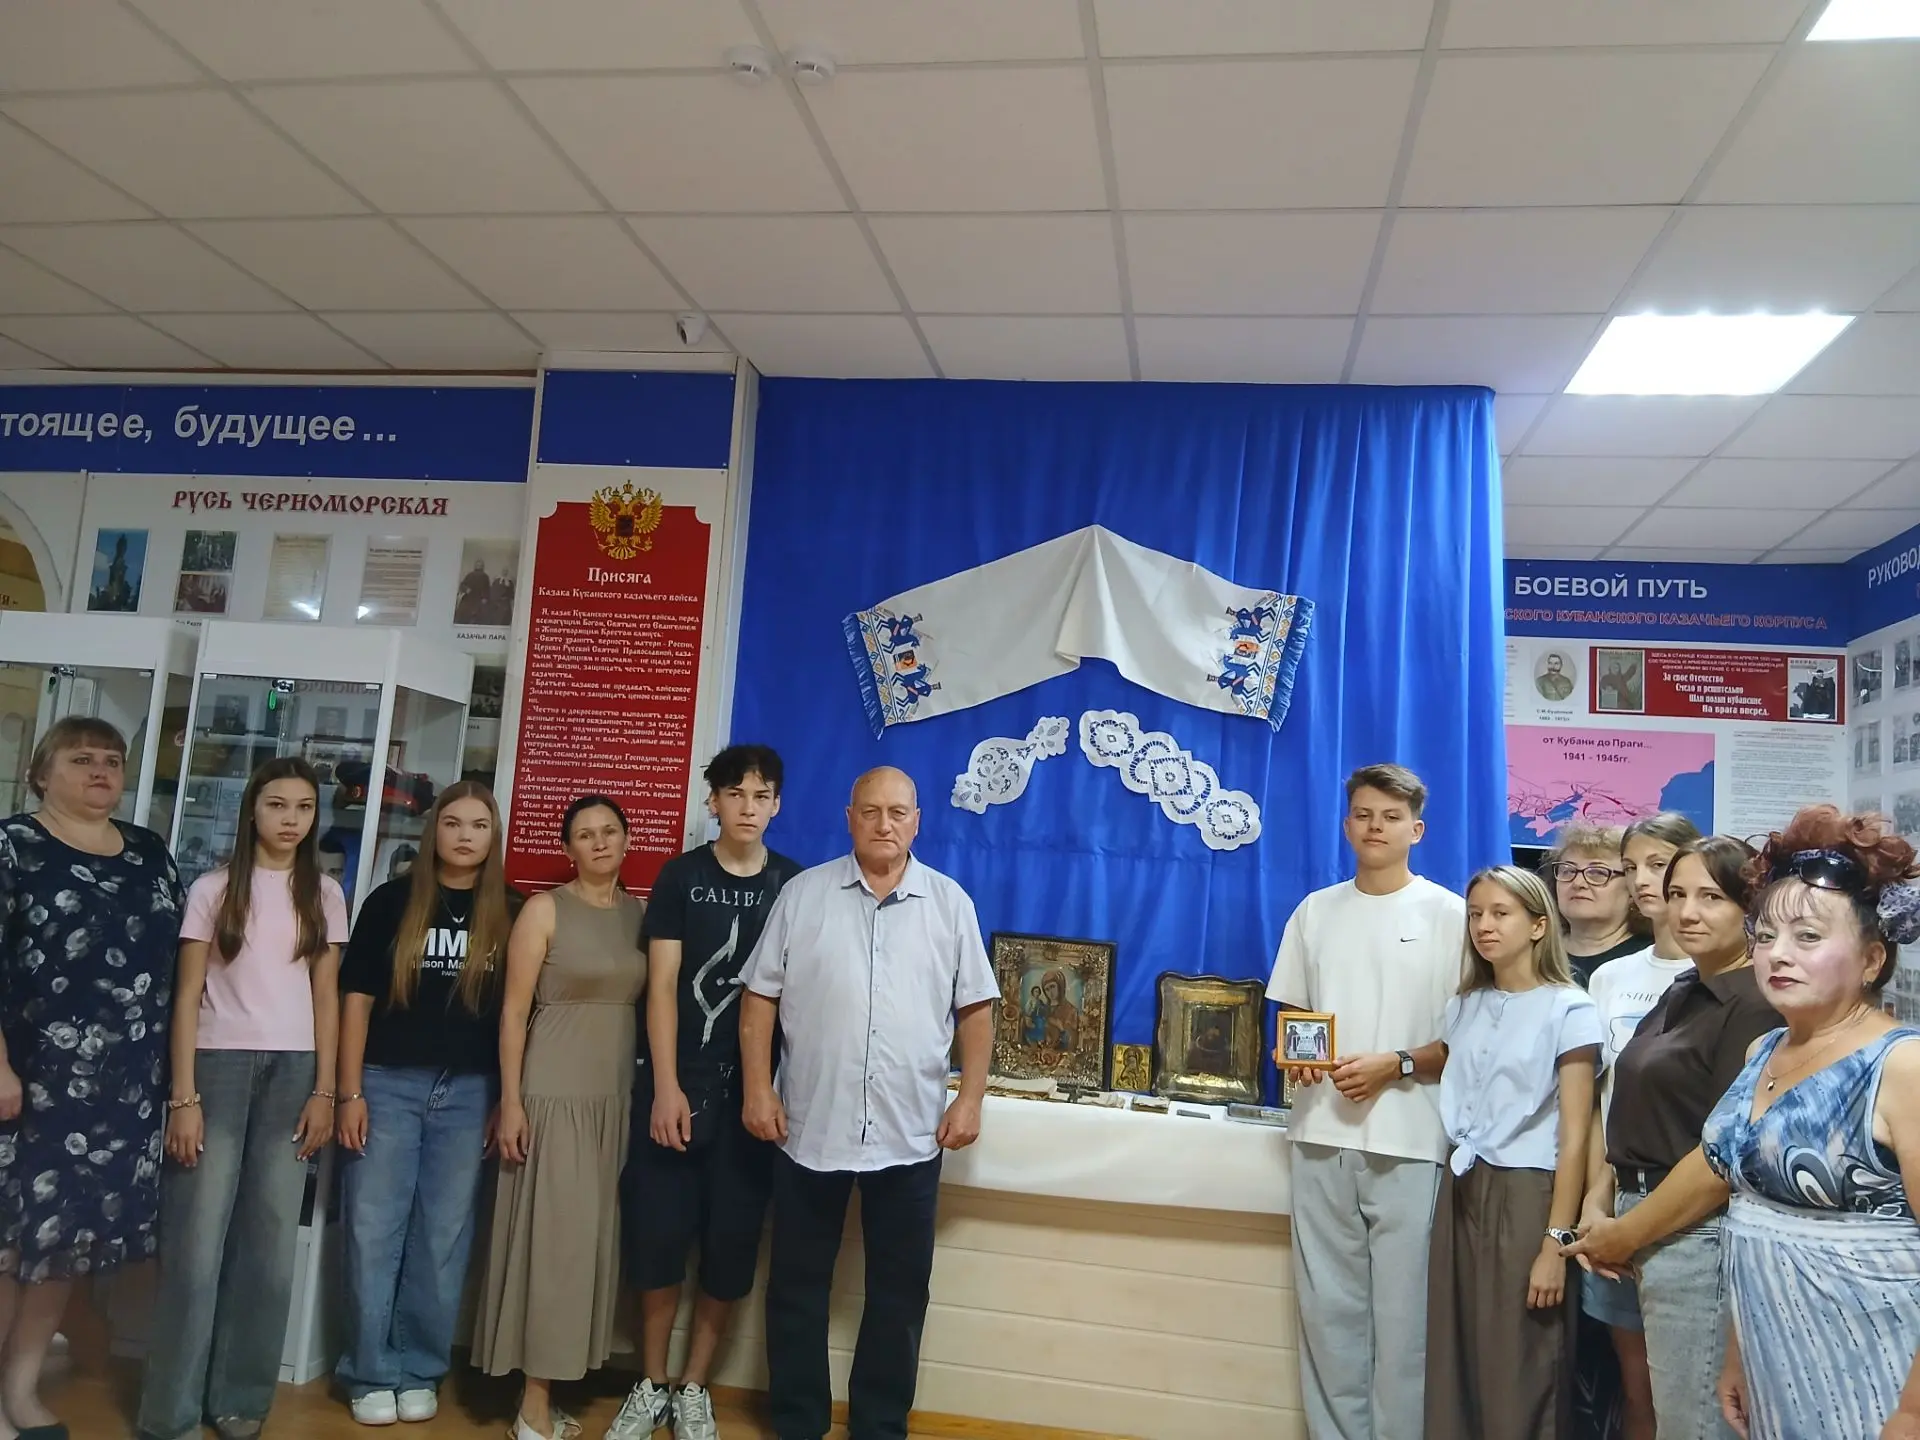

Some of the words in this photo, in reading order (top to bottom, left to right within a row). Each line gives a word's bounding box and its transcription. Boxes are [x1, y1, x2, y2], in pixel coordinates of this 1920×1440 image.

[0, 413, 152, 443] тоящее,
[172, 490, 232, 514] РУСЬ
[241, 491, 448, 516] ЧЕРНОМОРСКАЯ
[587, 566, 652, 586] Присяга
[1514, 573, 1628, 598] БОЕВОЙ
[1638, 578, 1708, 598] ПУТЬ
[538, 586, 570, 597] Казака
[623, 592, 667, 601] казачьего
[669, 593, 698, 602] войска
[1557, 610, 1657, 624] КУБАНСКОГО
[1659, 612, 1751, 627] КАЗАЧЬЕГО
[1753, 616, 1828, 630] КОРПУСА
[1663, 672, 1671, 681] За
[1673, 673, 1688, 682] свое
[1689, 673, 1724, 683] Отечество
[1676, 683, 1696, 692] Смело
[1703, 685, 1744, 694] решительно
[1702, 705, 1713, 713] На
[1715, 706, 1738, 715] врага
[1542, 737, 1554, 745] от
[1557, 736, 1595, 747] Кубани
[1597, 739, 1610, 748] до
[1563, 752, 1585, 761] 1941
